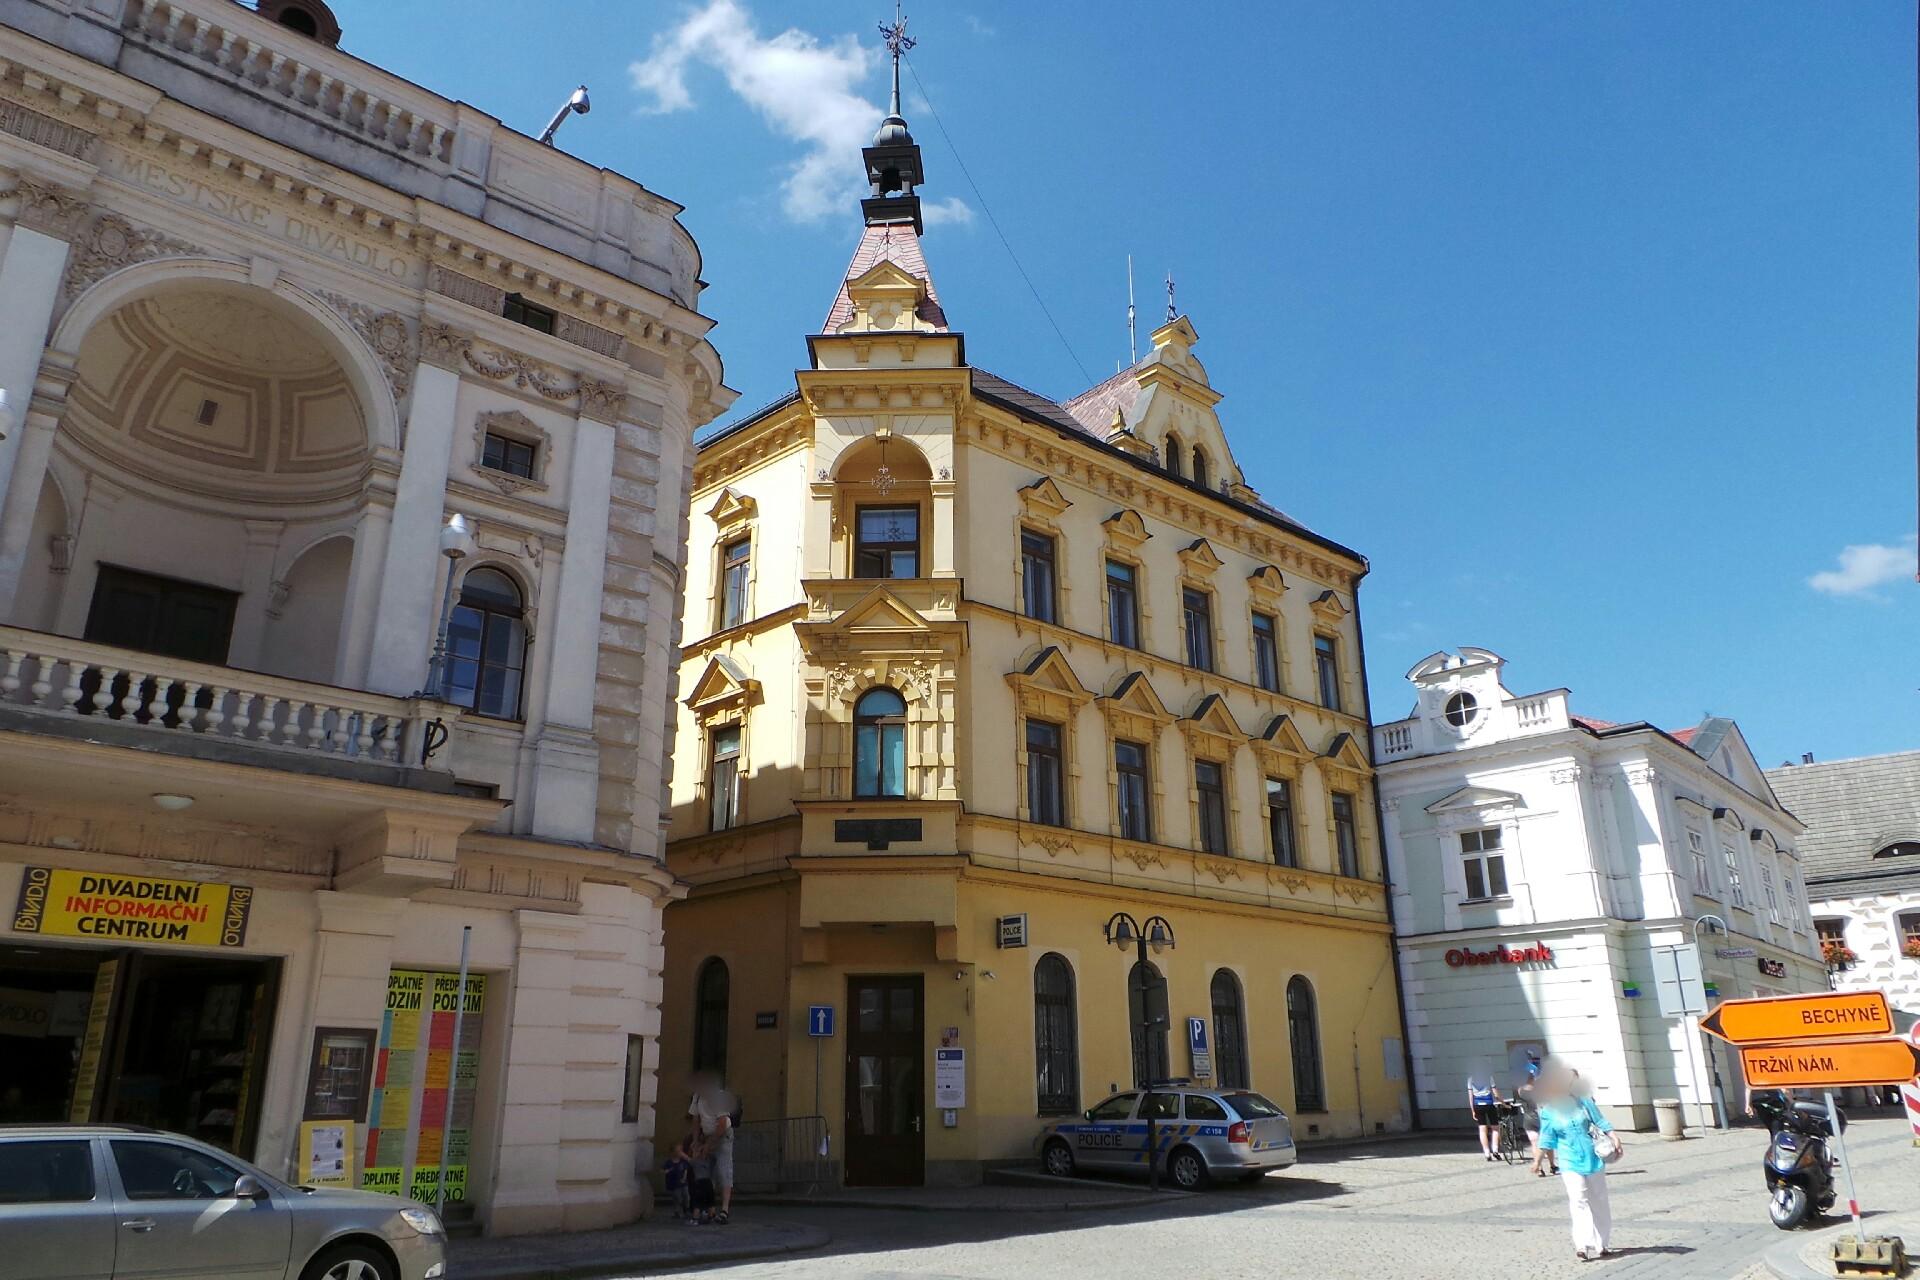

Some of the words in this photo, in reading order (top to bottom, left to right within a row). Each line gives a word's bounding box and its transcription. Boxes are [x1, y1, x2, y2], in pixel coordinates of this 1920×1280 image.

[286, 218, 407, 278] DIVADLO
[80, 877, 202, 904] DIVADELNÍ
[65, 896, 208, 923] INFORMAČNÍ
[78, 917, 188, 940] CENTRUM
[1445, 939, 1551, 967] Oberbank
[435, 976, 483, 993] PŘEDPATNÉ
[386, 991, 421, 1010] DZIM
[1802, 1004, 1881, 1024] BECHYNĚ
[1194, 1020, 1201, 1040] P
[1749, 1055, 1794, 1073] TRŽNÍ
[1798, 1054, 1839, 1072] NÁM.
[1079, 1134, 1122, 1146] POLICIE
[415, 1168, 464, 1183] PŘEDPATNÉ
